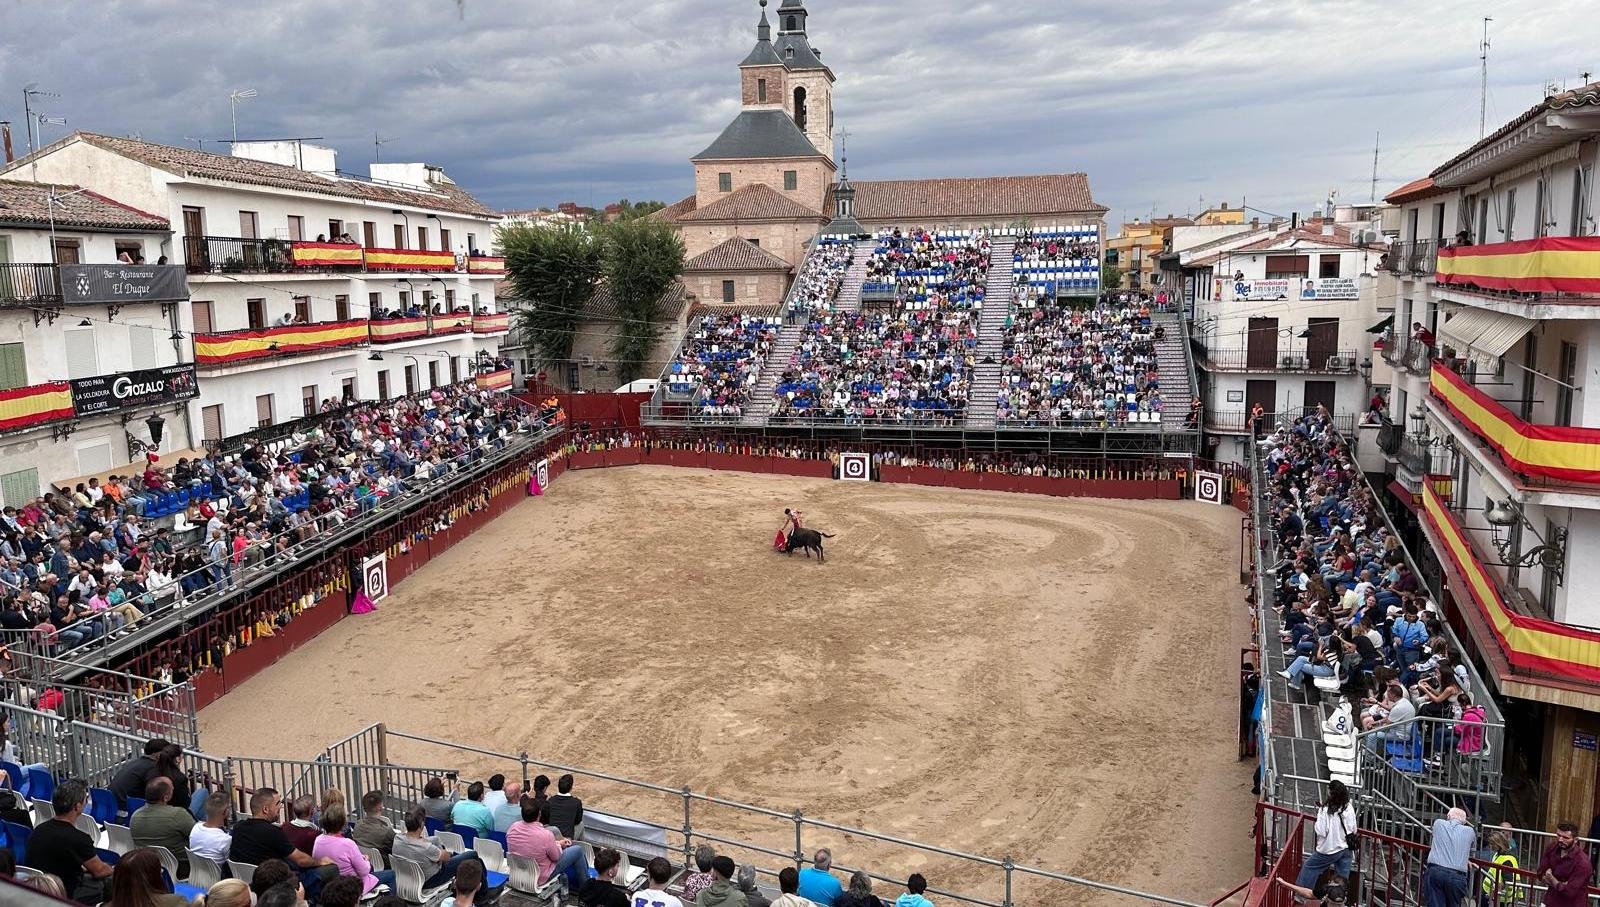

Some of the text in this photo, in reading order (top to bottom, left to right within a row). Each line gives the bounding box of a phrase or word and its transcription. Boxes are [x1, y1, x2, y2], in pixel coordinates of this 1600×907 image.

[112, 283, 150, 297] El Duque
[83, 390, 110, 400] SOLDADURA
[851, 463, 858, 471] 4
[1206, 484, 1212, 493] 5
[373, 574, 378, 590] 2
